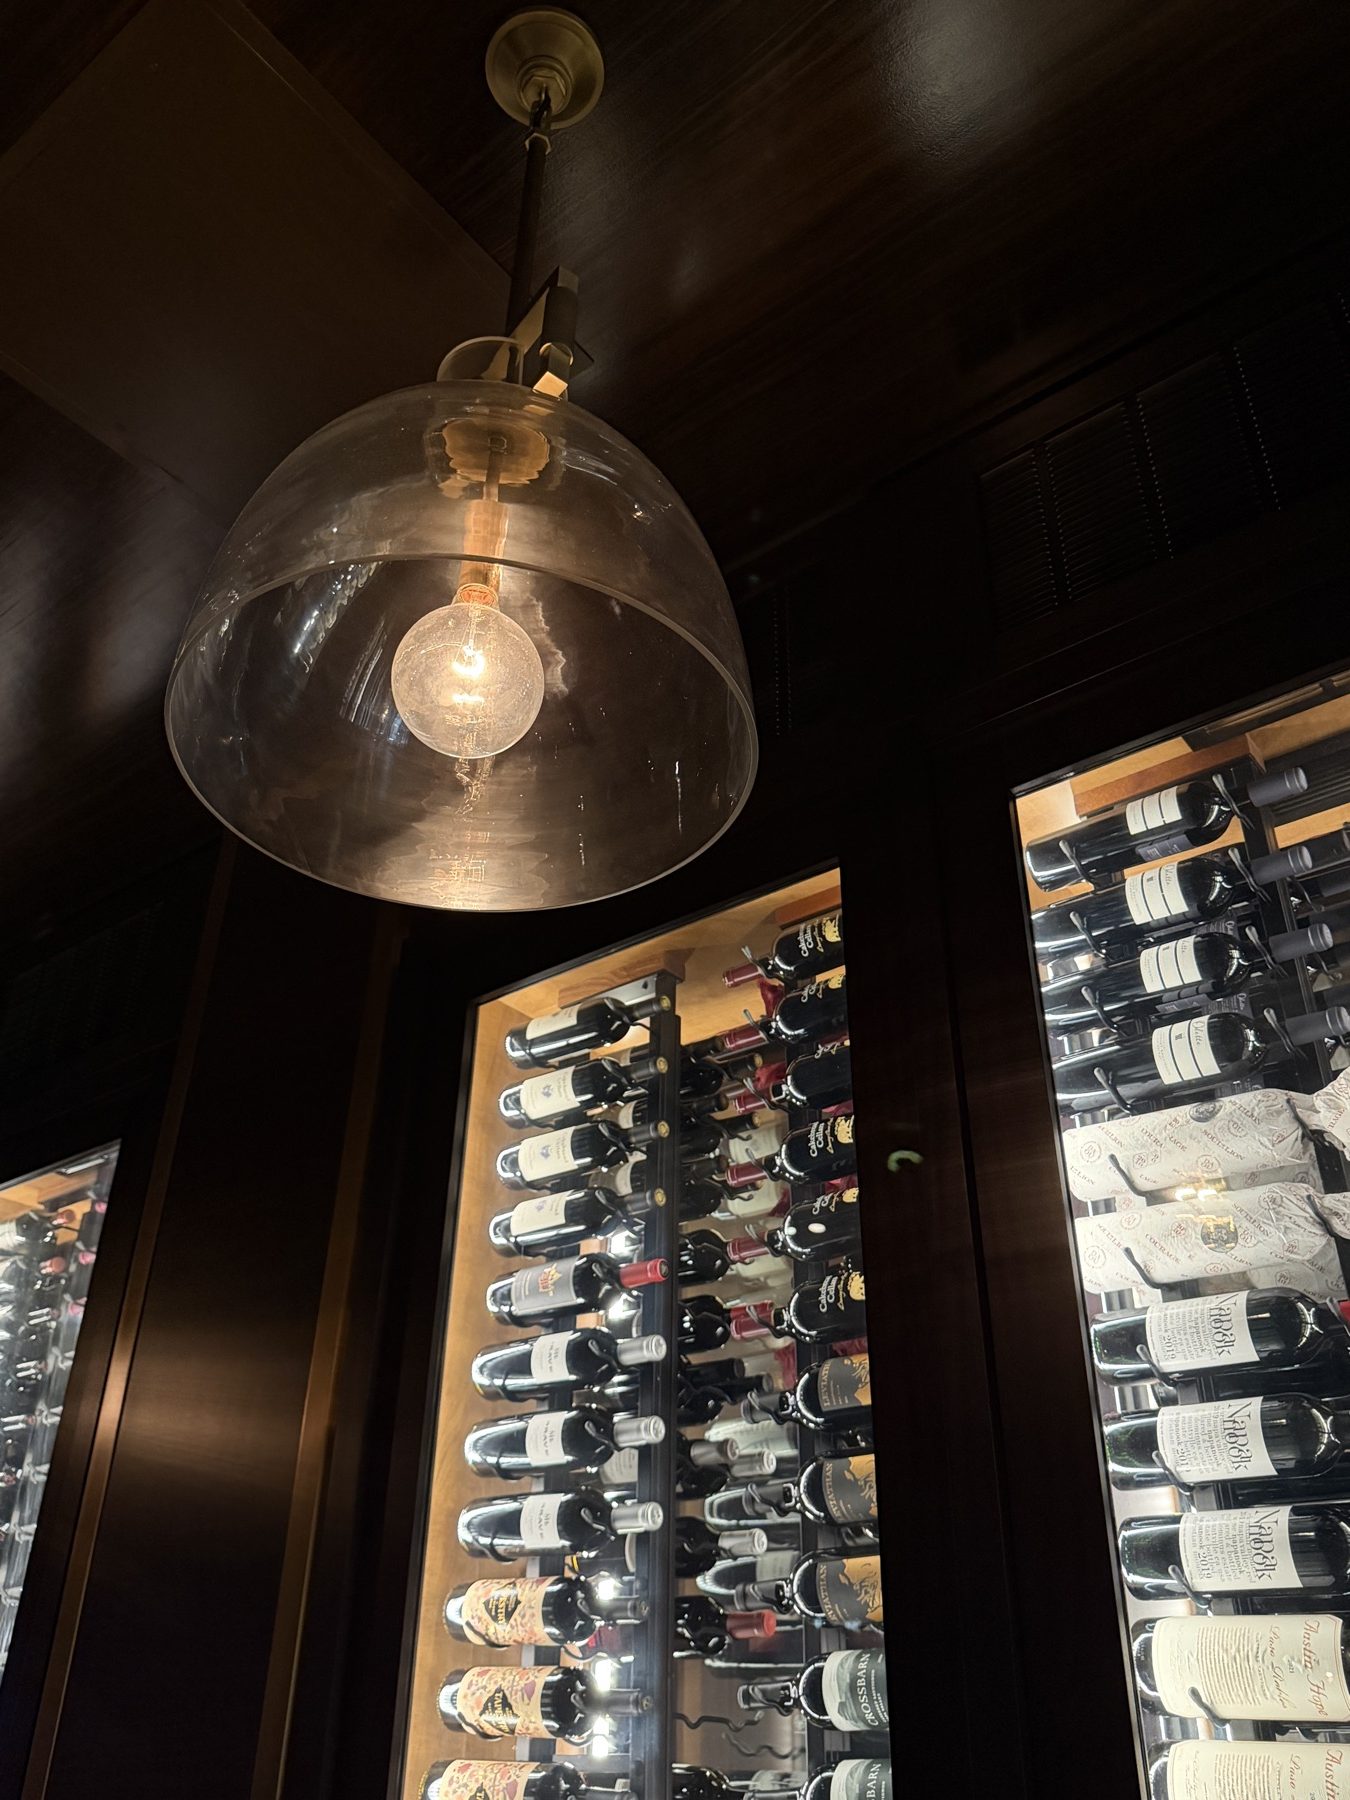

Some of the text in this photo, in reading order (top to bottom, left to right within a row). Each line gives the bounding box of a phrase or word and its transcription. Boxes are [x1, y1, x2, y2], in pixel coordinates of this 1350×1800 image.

[1197, 1552, 1212, 1579] 2019
[856, 1653, 879, 1726] CROSSBARN
[1303, 1620, 1329, 1717] Austin Hope
